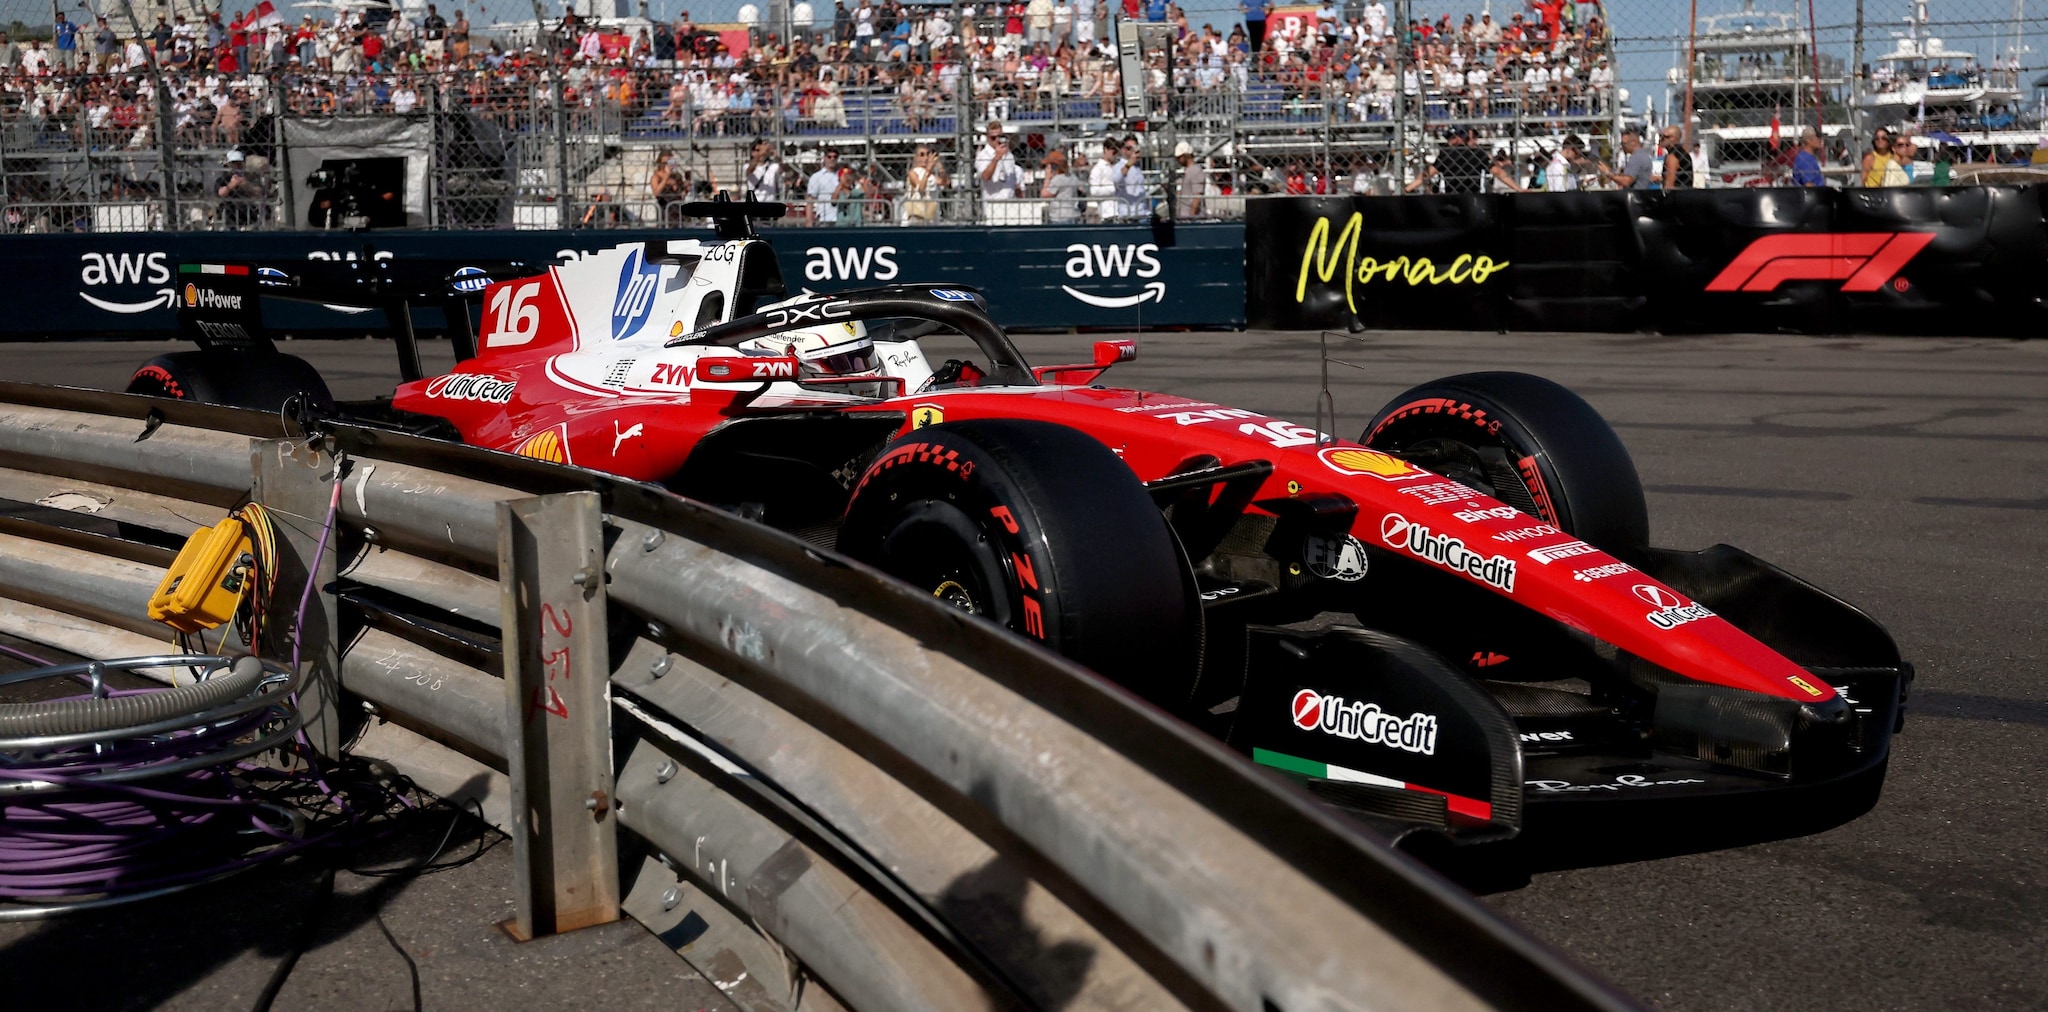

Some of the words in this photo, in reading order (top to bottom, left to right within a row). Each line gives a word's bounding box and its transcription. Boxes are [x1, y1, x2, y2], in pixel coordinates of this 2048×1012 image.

[81, 251, 170, 287] aws
[804, 245, 899, 281] aws
[1065, 243, 1161, 278] aws
[1296, 211, 1510, 315] Monaco
[196, 288, 242, 310] V-Power
[487, 282, 542, 348] 16
[651, 363, 697, 387] ZYN
[752, 361, 793, 377] ZYN
[1238, 421, 1331, 448] 16
[1408, 522, 1516, 593] UniCredit
[1321, 702, 1436, 756] UniCredit
